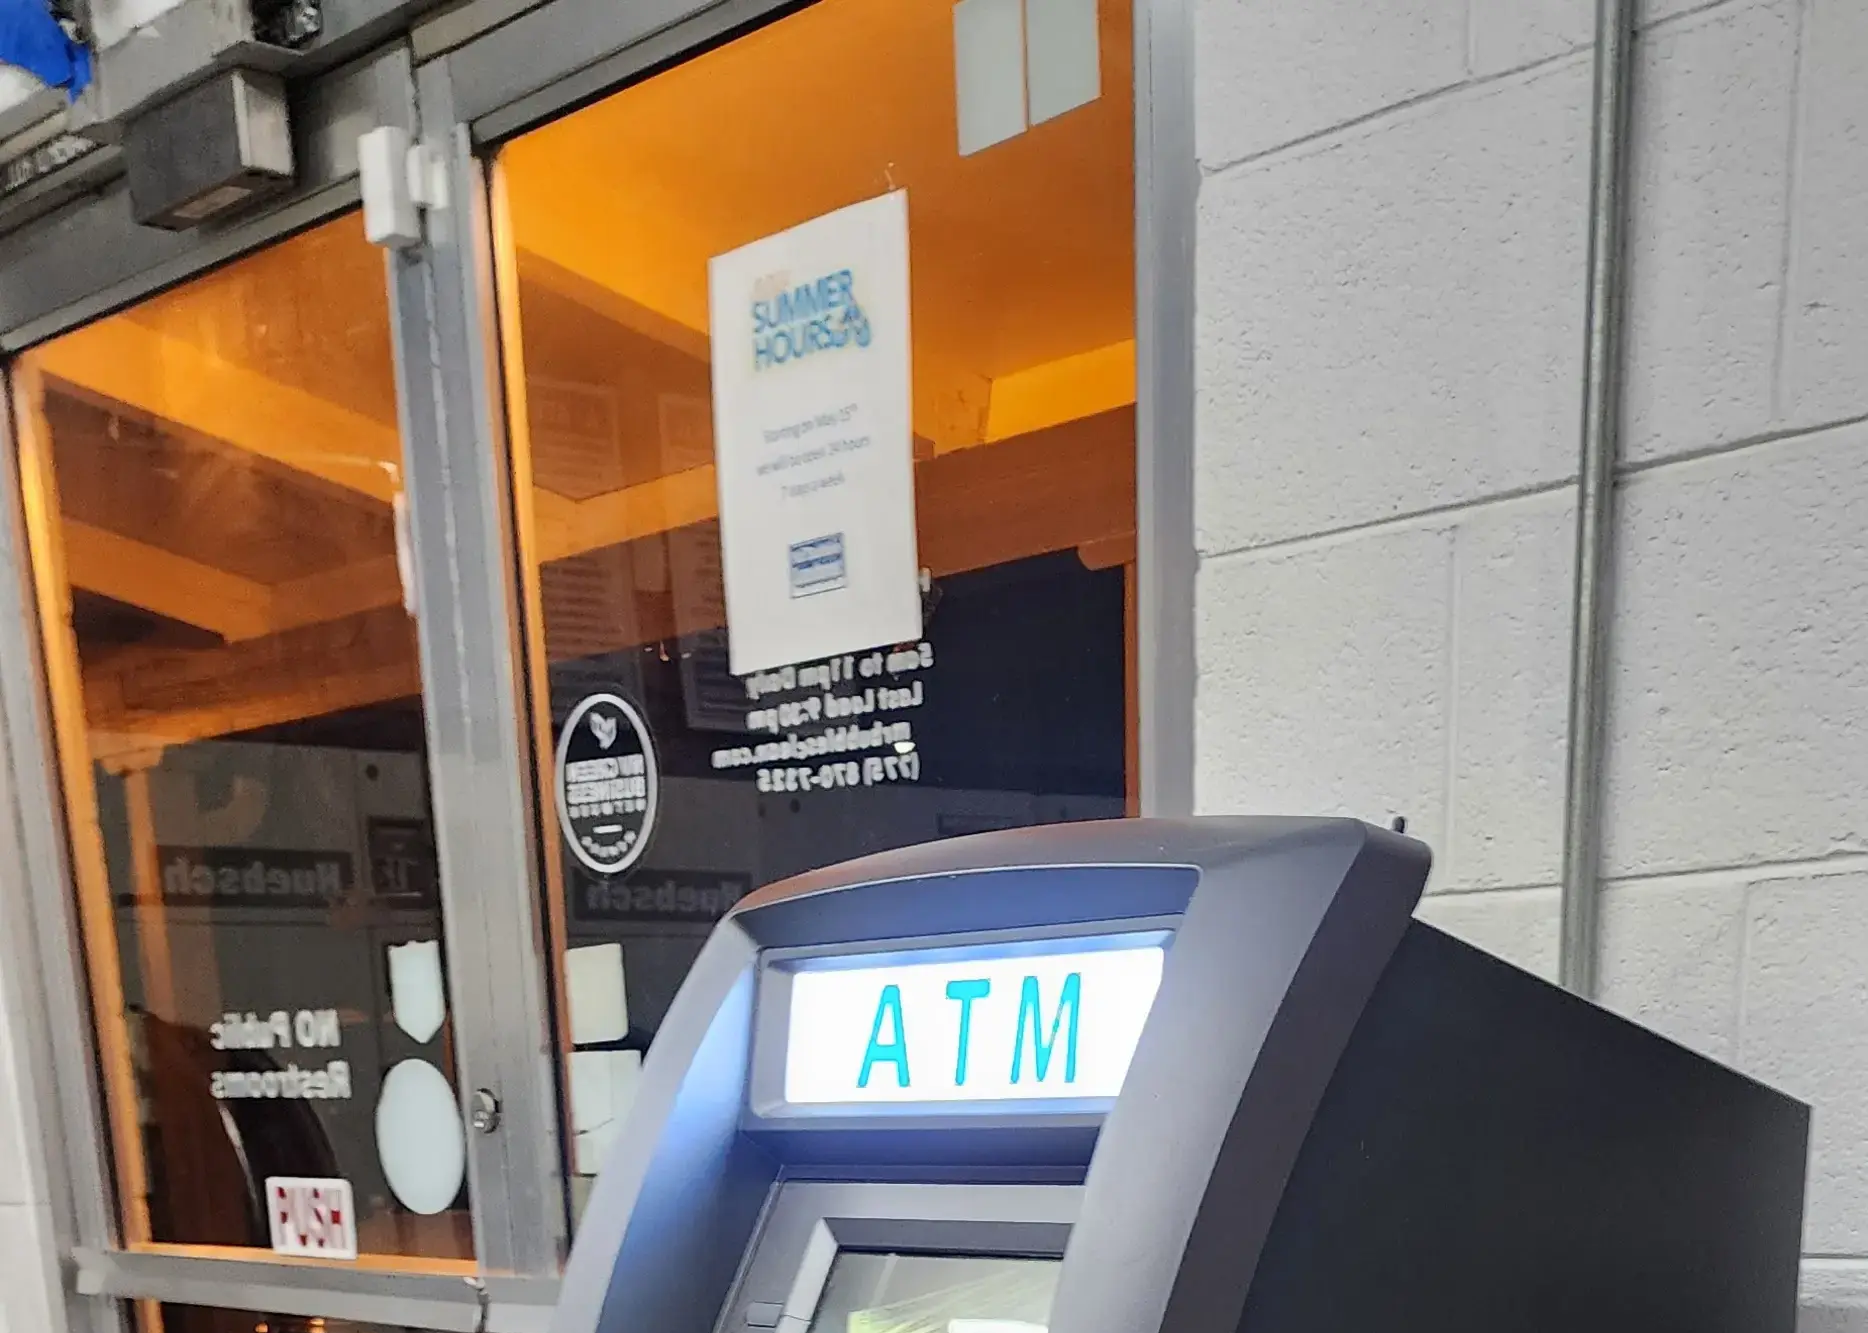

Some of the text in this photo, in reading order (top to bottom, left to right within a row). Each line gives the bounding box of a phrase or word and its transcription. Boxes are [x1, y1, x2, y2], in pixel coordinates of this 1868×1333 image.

[752, 269, 853, 334] SUMMER
[754, 320, 831, 371] HOURS
[857, 972, 1081, 1088] ATM
[275, 1187, 348, 1249] PUSH
